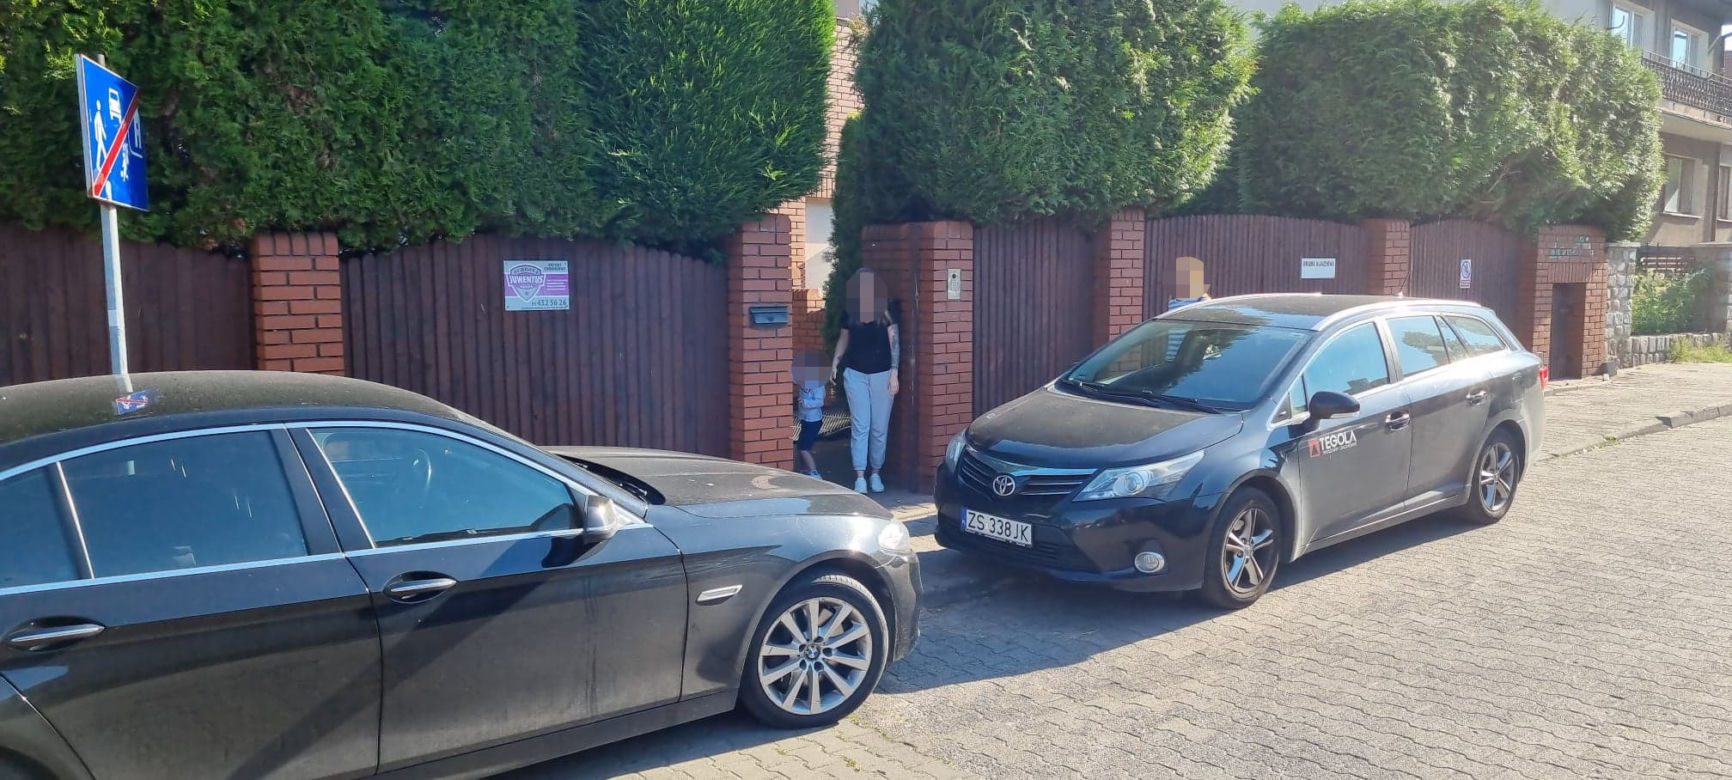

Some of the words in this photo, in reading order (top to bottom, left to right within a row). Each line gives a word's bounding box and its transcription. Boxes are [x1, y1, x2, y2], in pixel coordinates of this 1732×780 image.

[1319, 430, 1357, 451] TEGOLA
[968, 511, 985, 531] ZS
[989, 517, 1029, 542] 338JK
